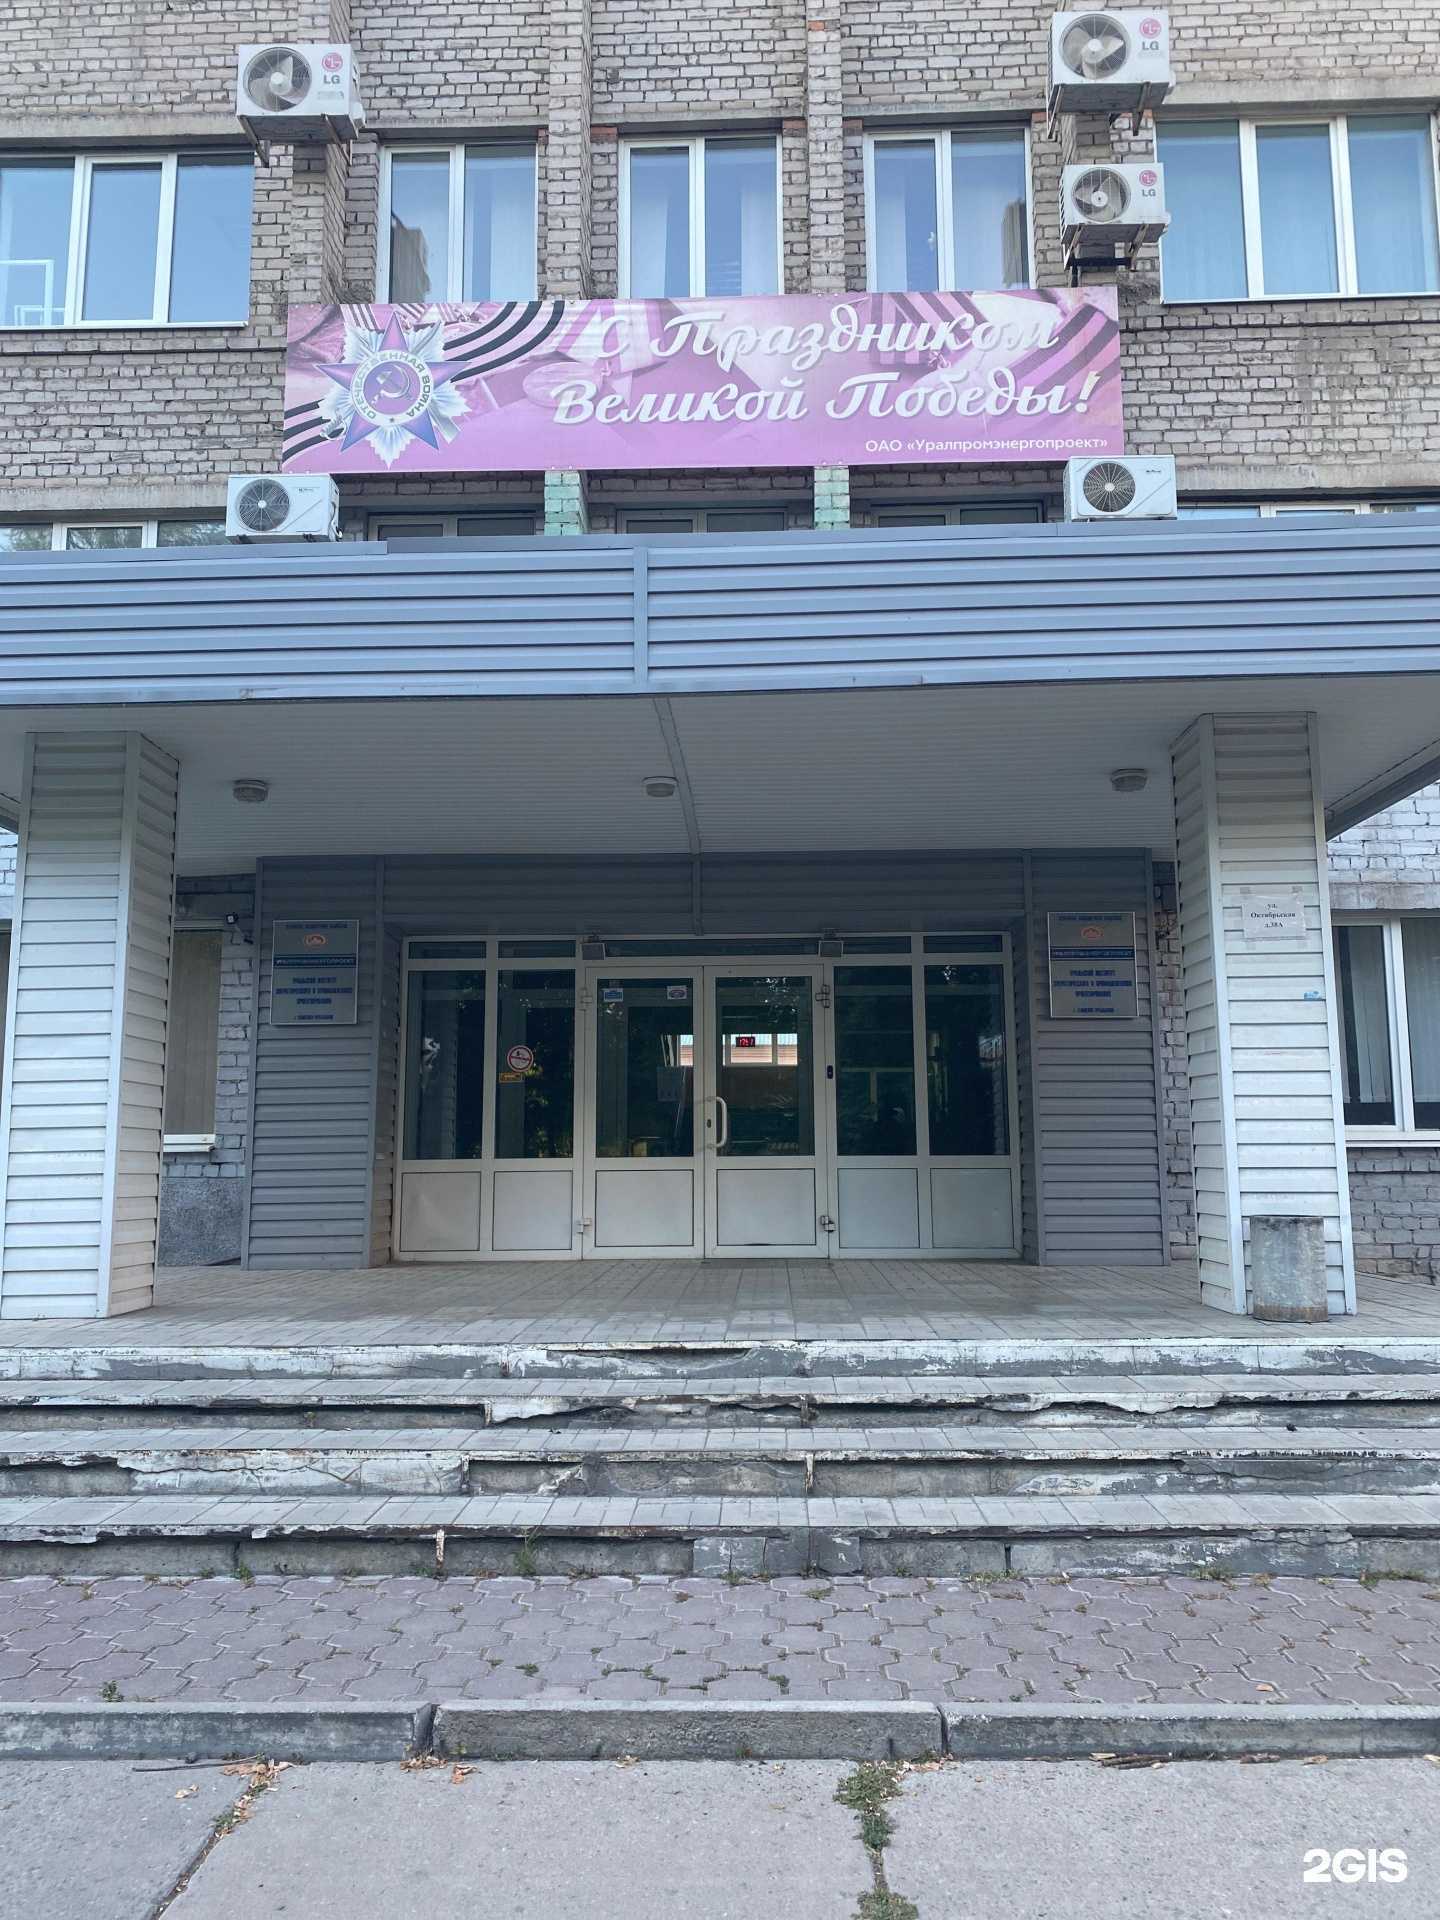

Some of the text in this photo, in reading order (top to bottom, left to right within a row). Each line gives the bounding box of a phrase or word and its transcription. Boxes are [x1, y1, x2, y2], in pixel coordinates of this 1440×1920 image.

[1142, 40, 1160, 51] LG
[323, 74, 341, 85] LG
[1142, 188, 1157, 197] LG
[650, 297, 1059, 373] Праздником
[551, 367, 1102, 425] Великой Победы!
[865, 437, 1108, 453] ОАО «Уралпромэнергопроект»
